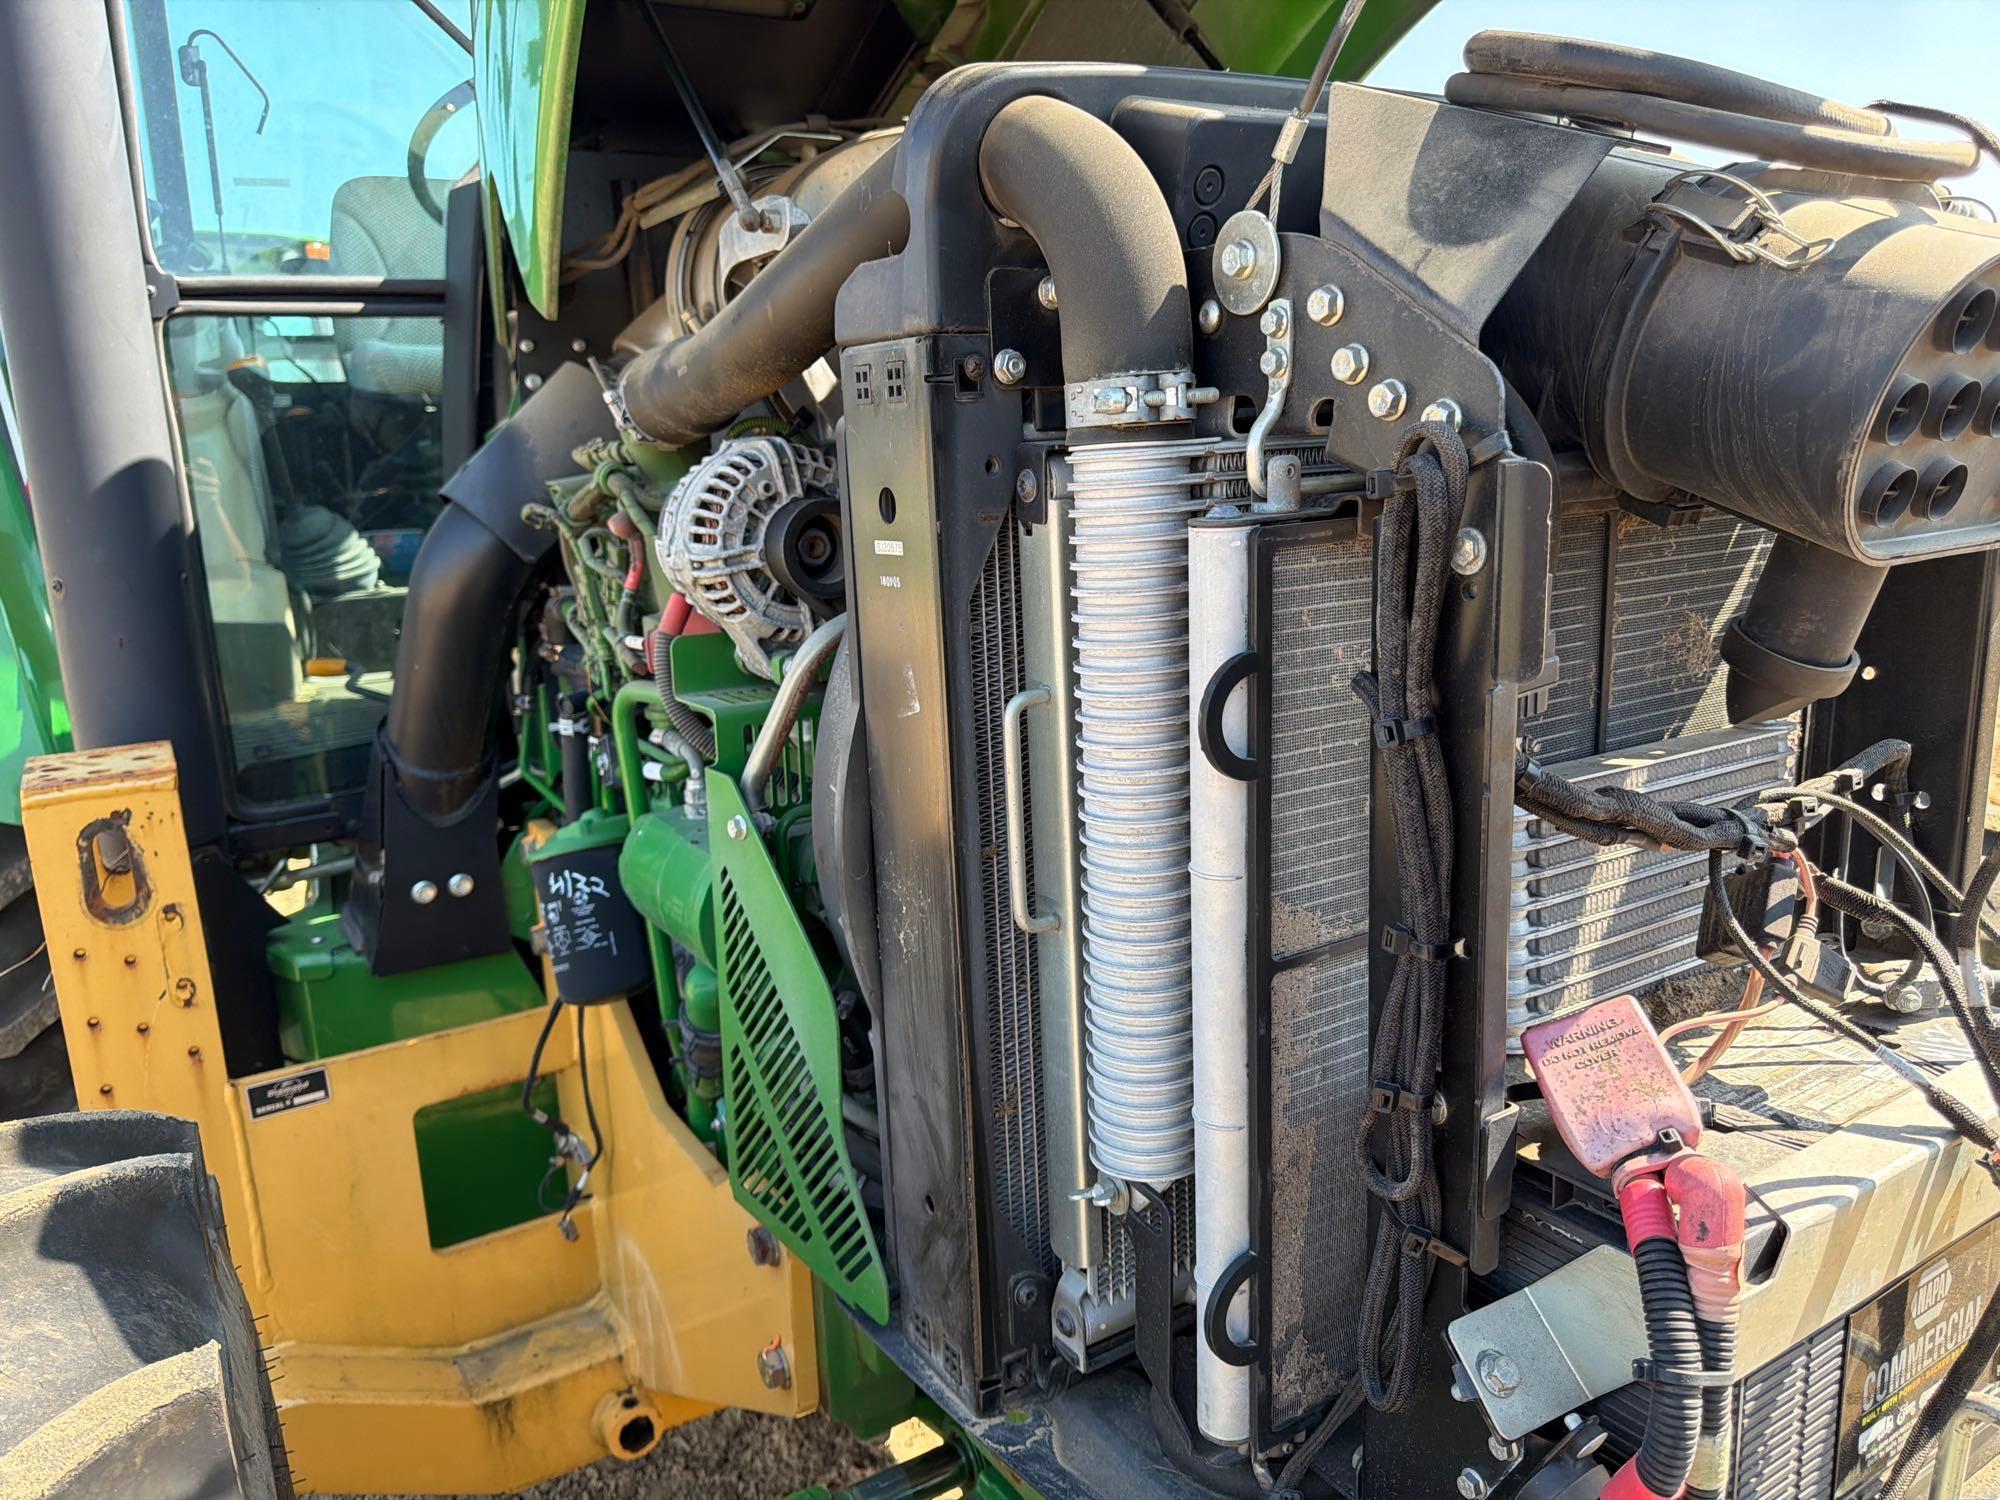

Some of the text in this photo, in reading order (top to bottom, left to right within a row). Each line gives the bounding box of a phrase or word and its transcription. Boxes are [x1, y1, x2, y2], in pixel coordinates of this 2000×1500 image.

[1541, 1026, 1641, 1067] DO NOT REMOVE
[1545, 1018, 1617, 1049] WARNING
[1575, 1049, 1618, 1069] COVER
[1917, 1272, 1946, 1316] NAPA
[1861, 1407, 1880, 1427] BUILT
[1881, 1394, 1898, 1412] WITH
[1898, 1377, 1921, 1400] POWER
